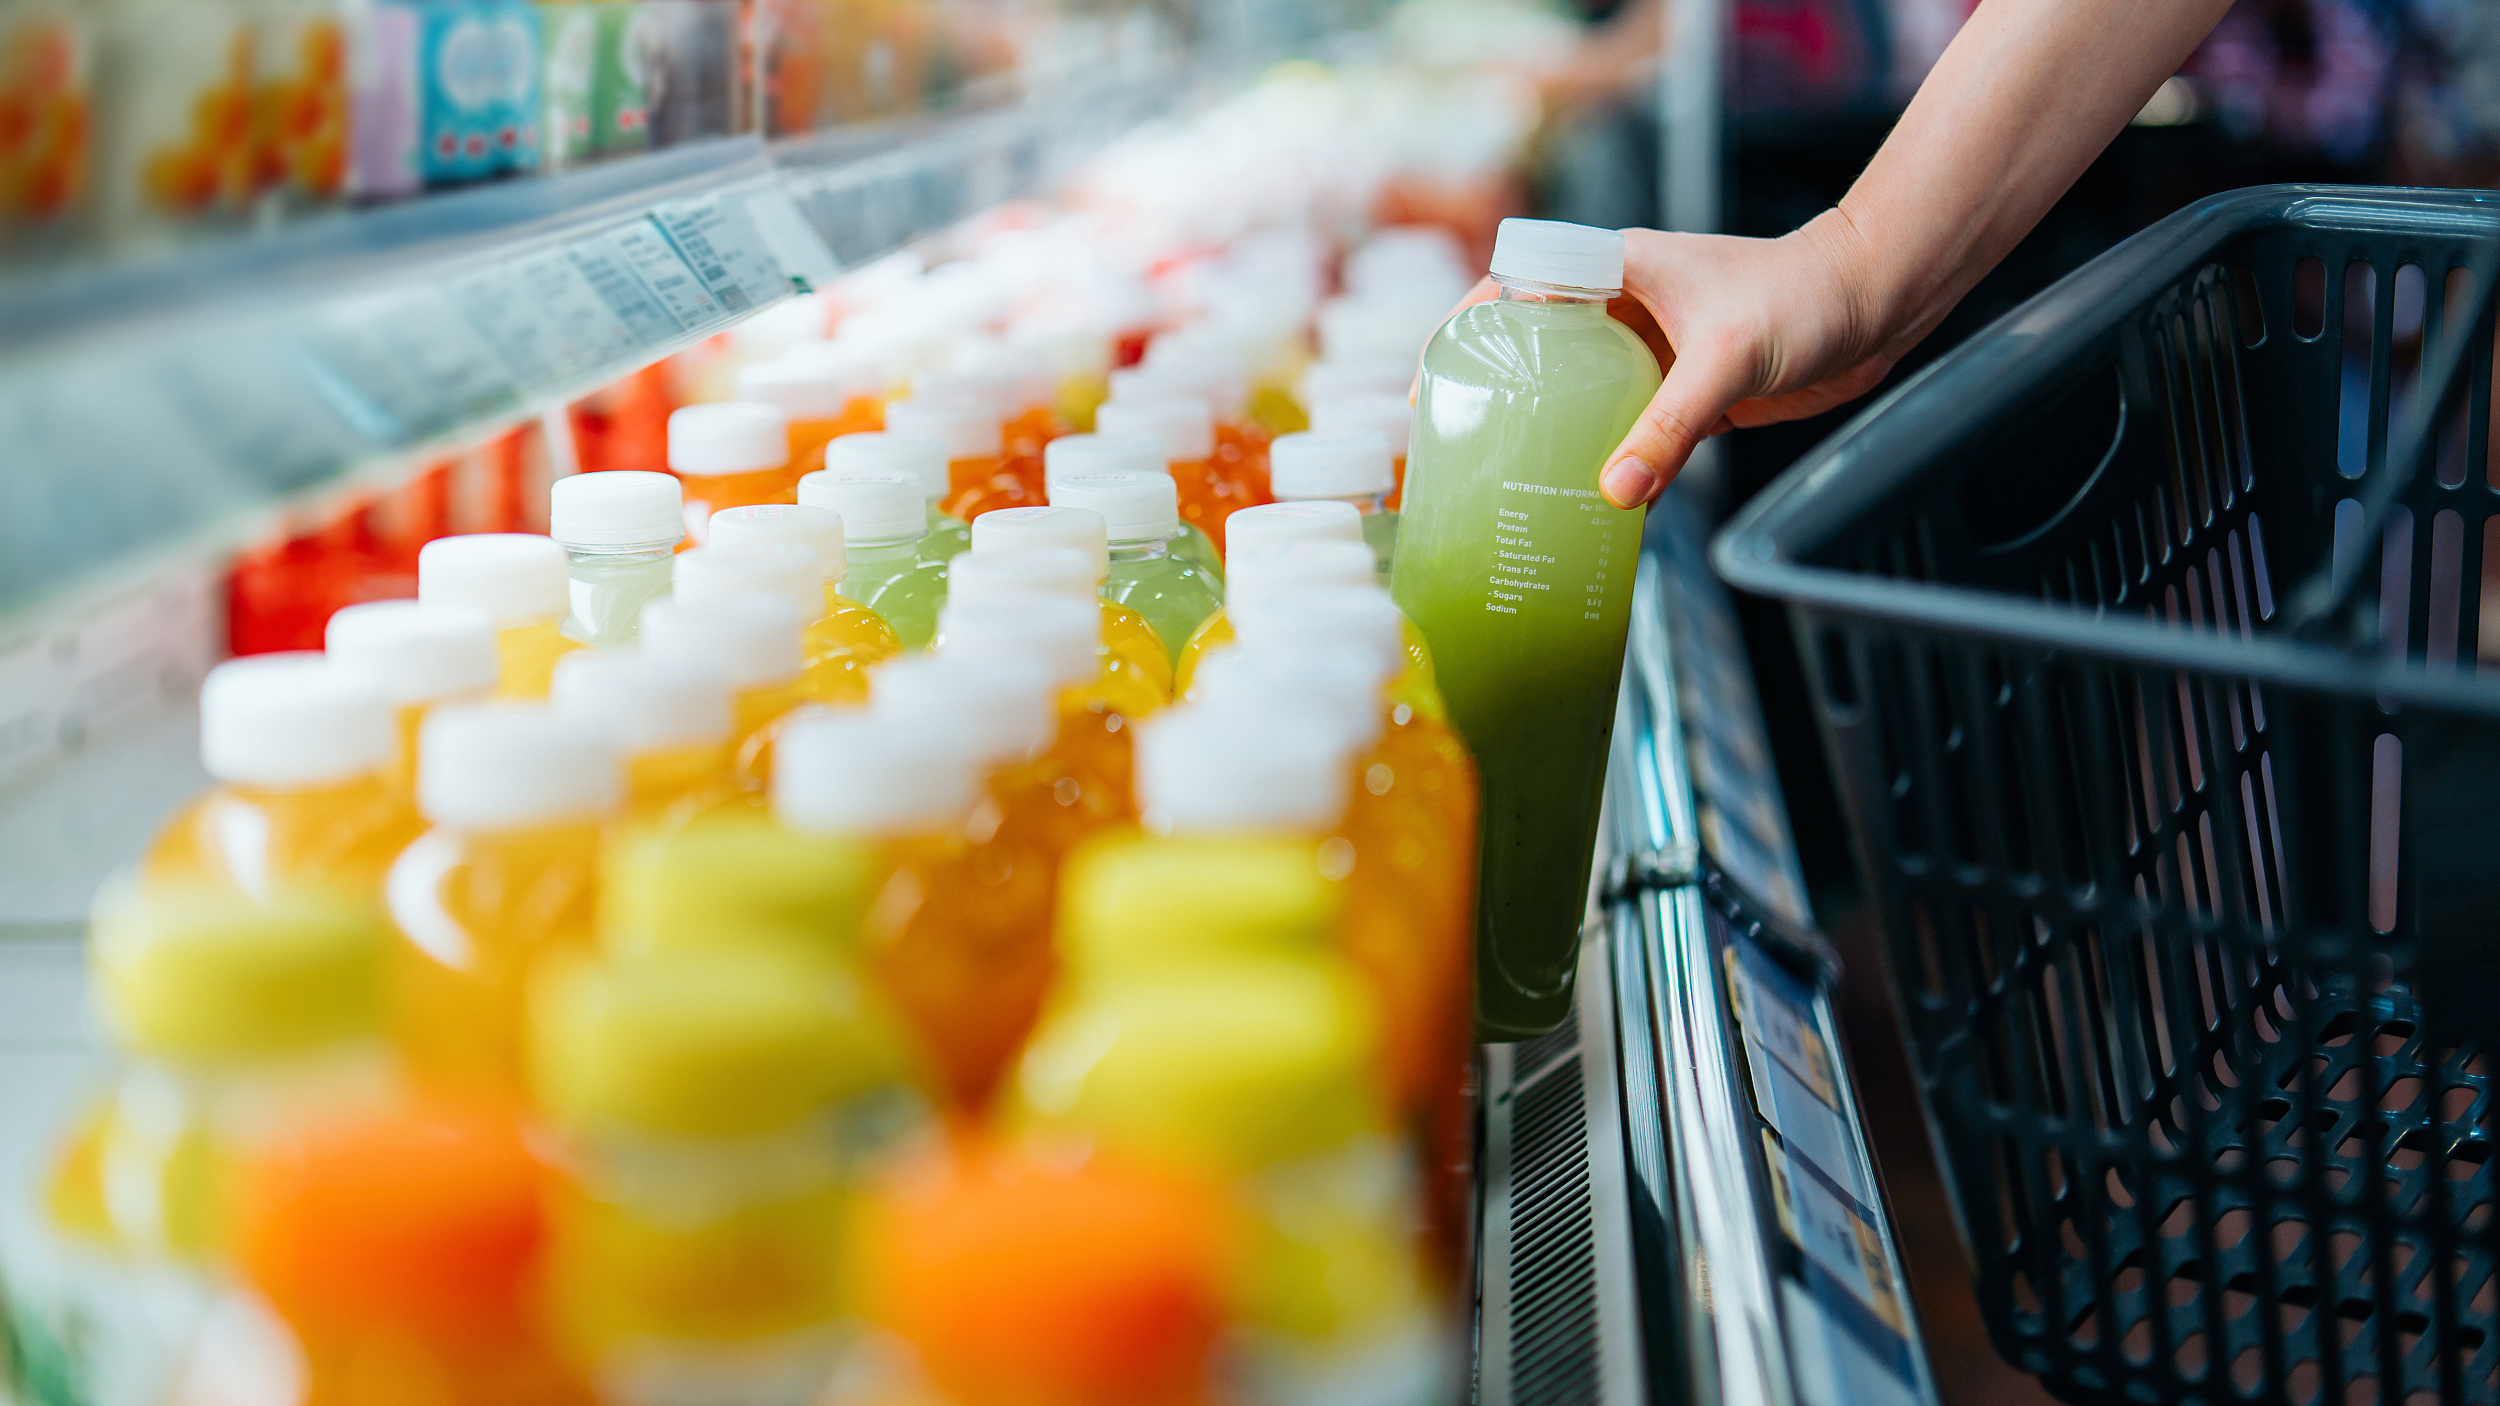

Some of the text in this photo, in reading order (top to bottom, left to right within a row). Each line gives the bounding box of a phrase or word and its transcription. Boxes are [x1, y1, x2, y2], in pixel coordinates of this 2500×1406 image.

[1502, 480, 1557, 495] NUTRITION
[1580, 503, 1593, 511] Per
[1499, 507, 1529, 521] Energy
[1497, 521, 1528, 533] Protein
[1495, 535, 1532, 548] Total Fat
[1498, 549, 1540, 562] Saturated
[1541, 554, 1555, 564] Fat
[1497, 562, 1522, 574] Trans
[1523, 566, 1537, 575] Fat
[1489, 575, 1550, 590] Carbohydrates
[1586, 585, 1599, 593] 10.7
[1493, 590, 1523, 601] Sugars
[1485, 602, 1517, 614] Sodium
[1590, 613, 1600, 621] mg
